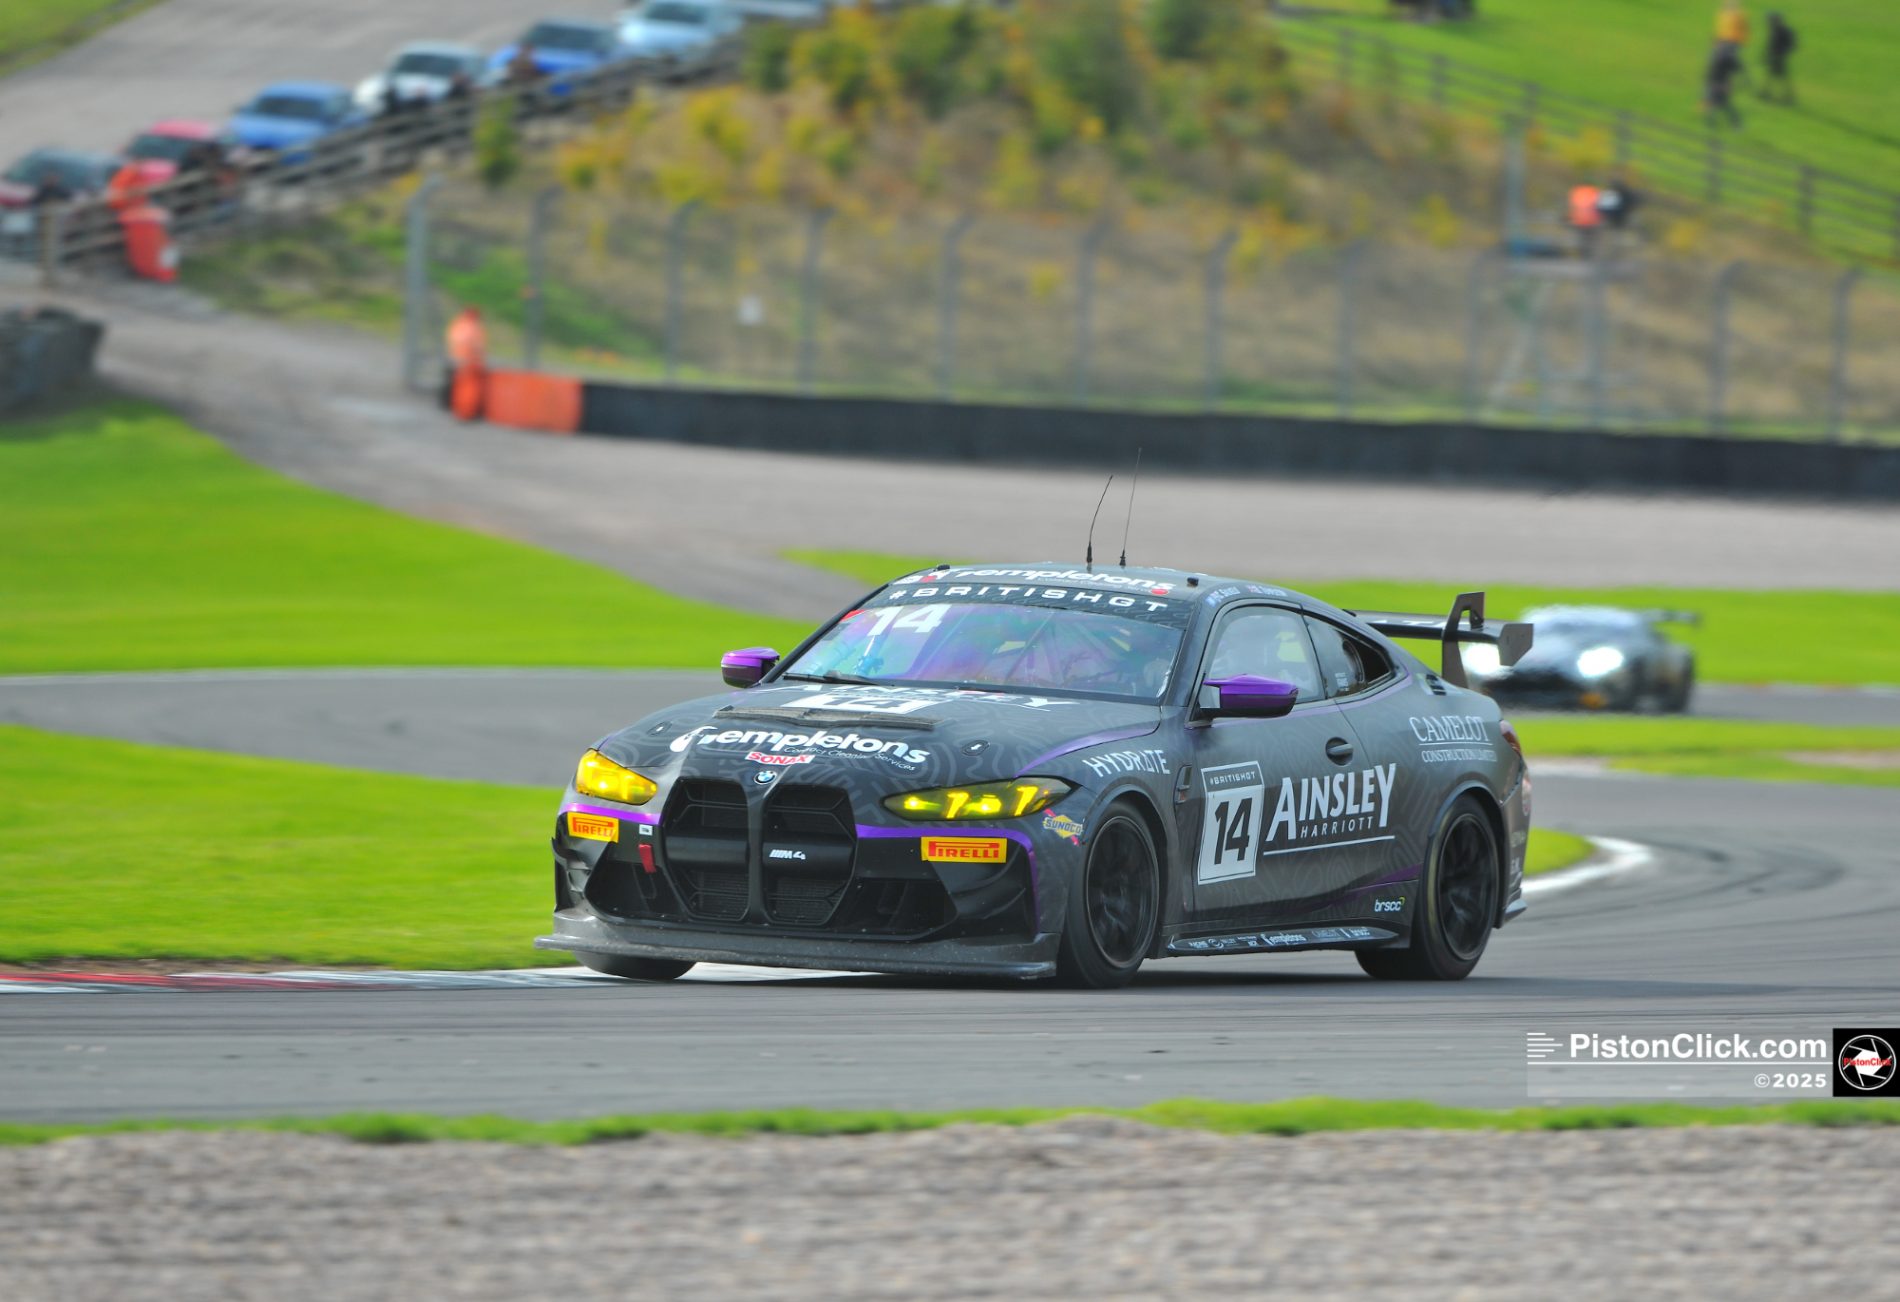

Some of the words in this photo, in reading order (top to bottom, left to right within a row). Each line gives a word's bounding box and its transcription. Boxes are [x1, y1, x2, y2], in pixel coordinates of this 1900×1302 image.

[889, 585, 1168, 612] #BRITISHGT
[867, 603, 952, 636] 14
[1408, 715, 1490, 742] CAMELOT
[669, 726, 931, 763] Templetons
[748, 752, 808, 765] SONAX
[1082, 749, 1170, 777] HYDRATE
[1265, 763, 1397, 842] AINSLEY
[572, 816, 615, 837] PIRELLI
[1045, 818, 1083, 835] SUNOCO
[1213, 797, 1253, 865] 14
[1300, 816, 1374, 839] HARRIOTT
[928, 841, 999, 858] PIRELLI
[1374, 898, 1402, 912] brscc
